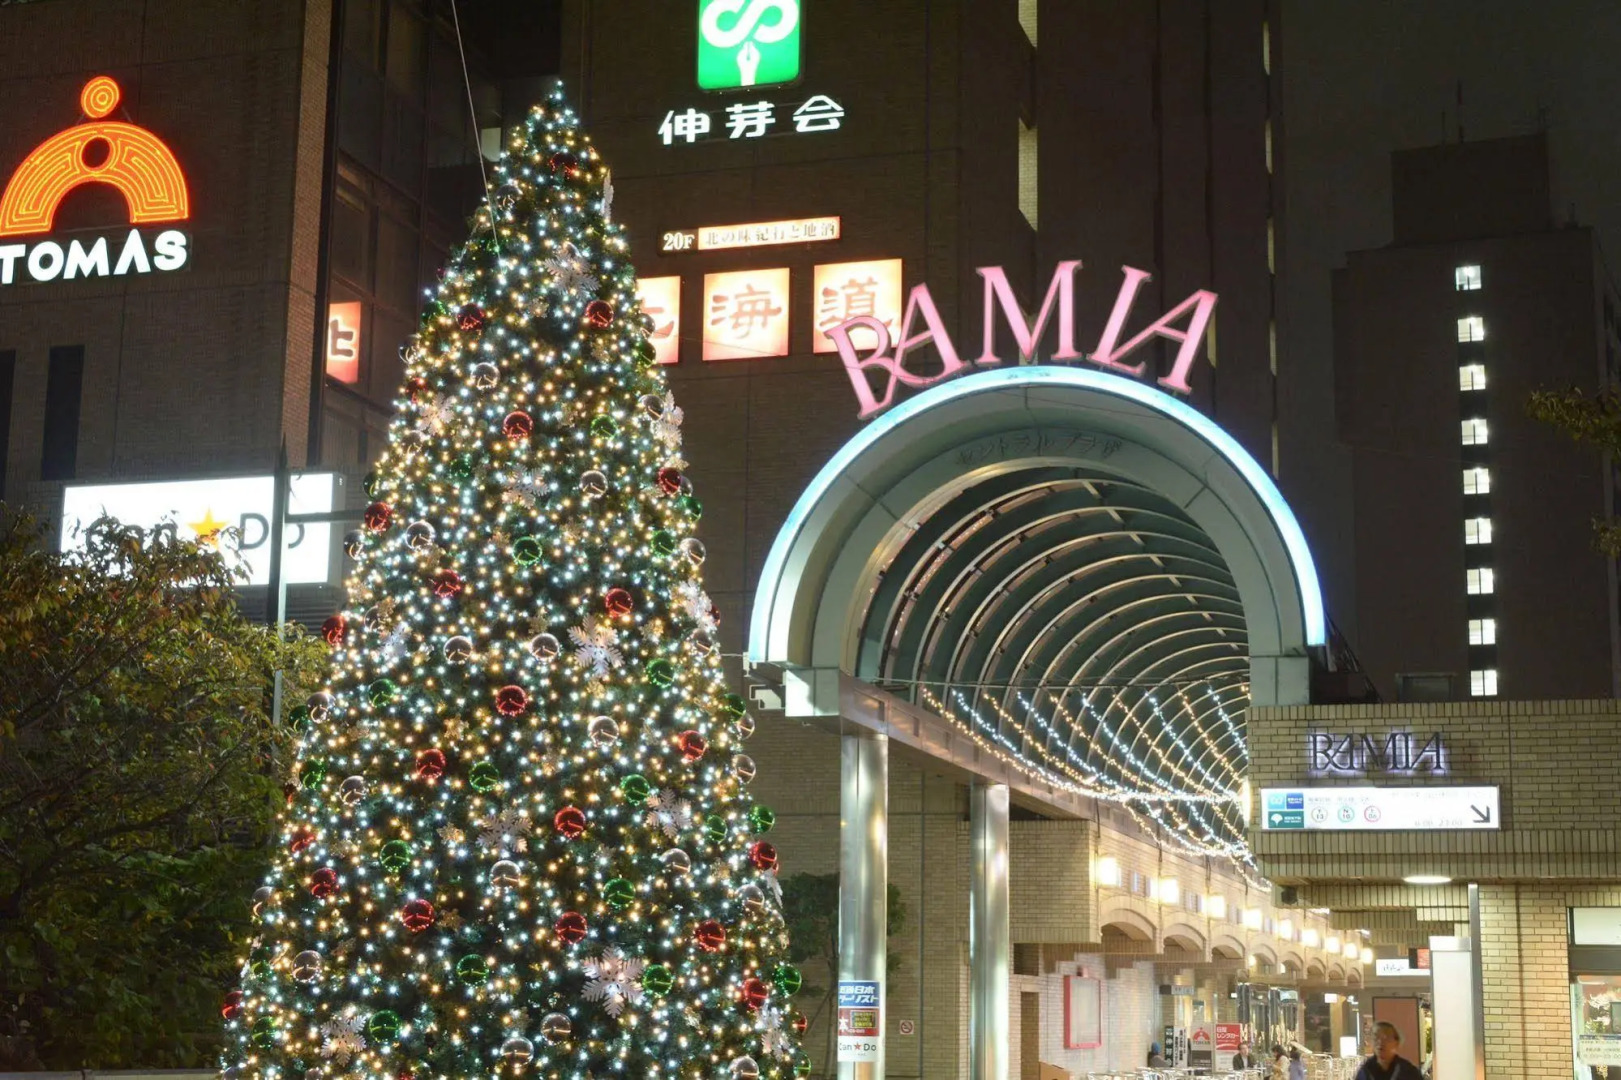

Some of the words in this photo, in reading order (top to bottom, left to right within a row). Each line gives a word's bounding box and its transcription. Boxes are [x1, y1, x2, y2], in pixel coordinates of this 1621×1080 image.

[658, 95, 845, 145] 伸芽会
[0, 229, 187, 284] TOMAS
[663, 232, 694, 250] 20F
